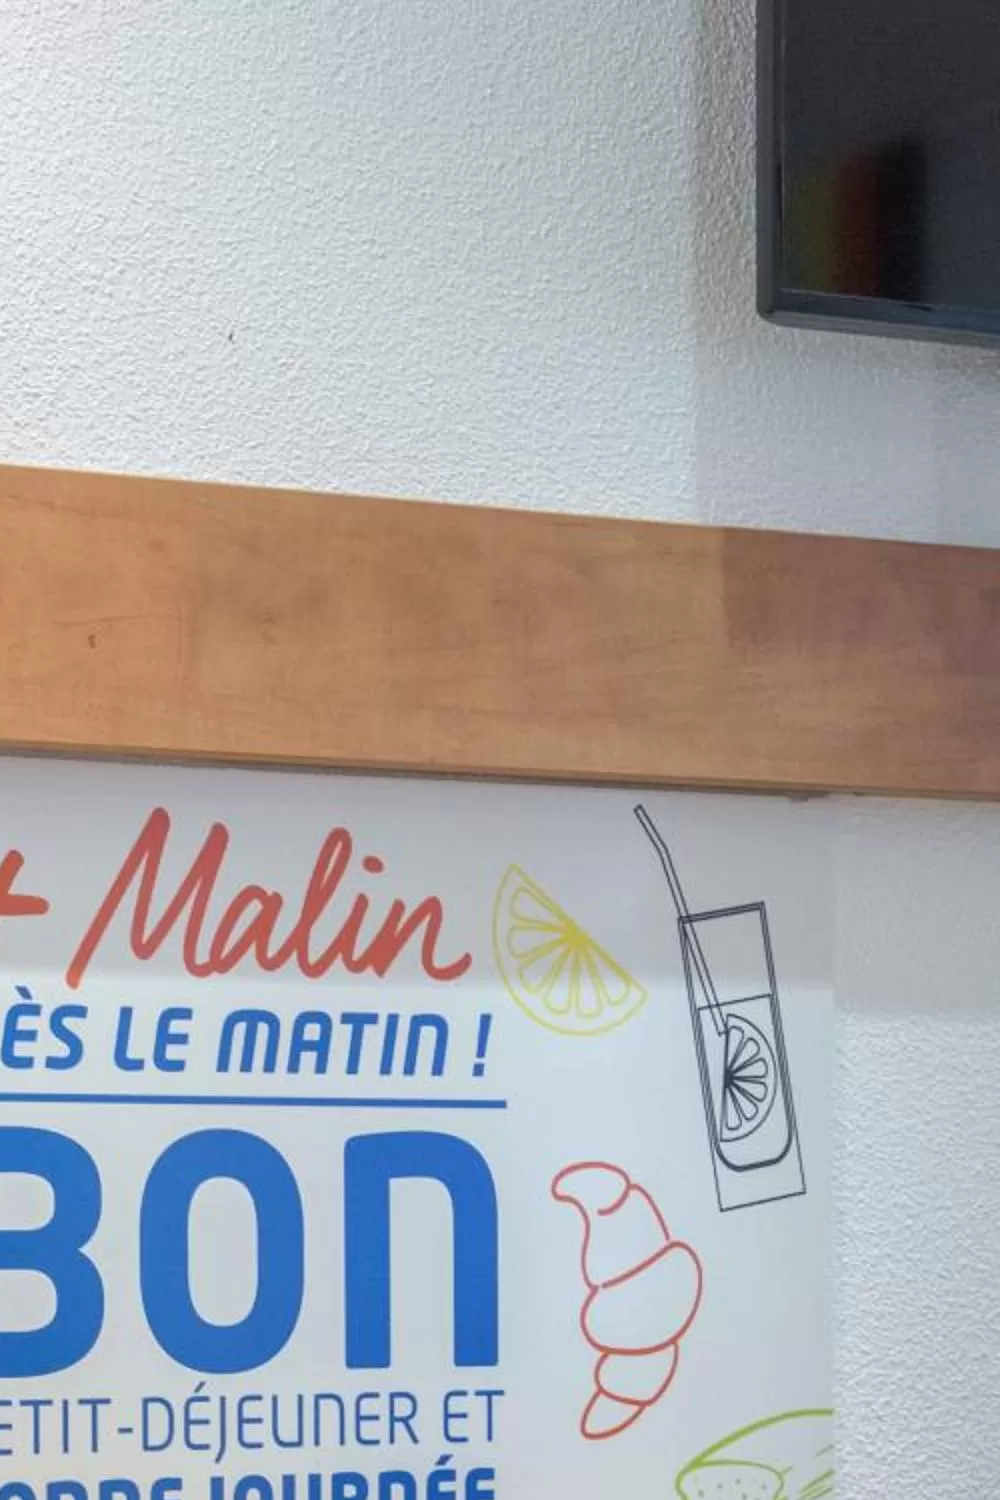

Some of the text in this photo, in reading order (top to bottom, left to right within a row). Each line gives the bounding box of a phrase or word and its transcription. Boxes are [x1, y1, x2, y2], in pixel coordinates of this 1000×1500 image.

[65, 806, 473, 989] Malin
[111, 1005, 195, 1074] LE
[215, 1007, 451, 1079] MATIN
[471, 1010, 493, 1080] !
[442, 1389, 505, 1445] ET
